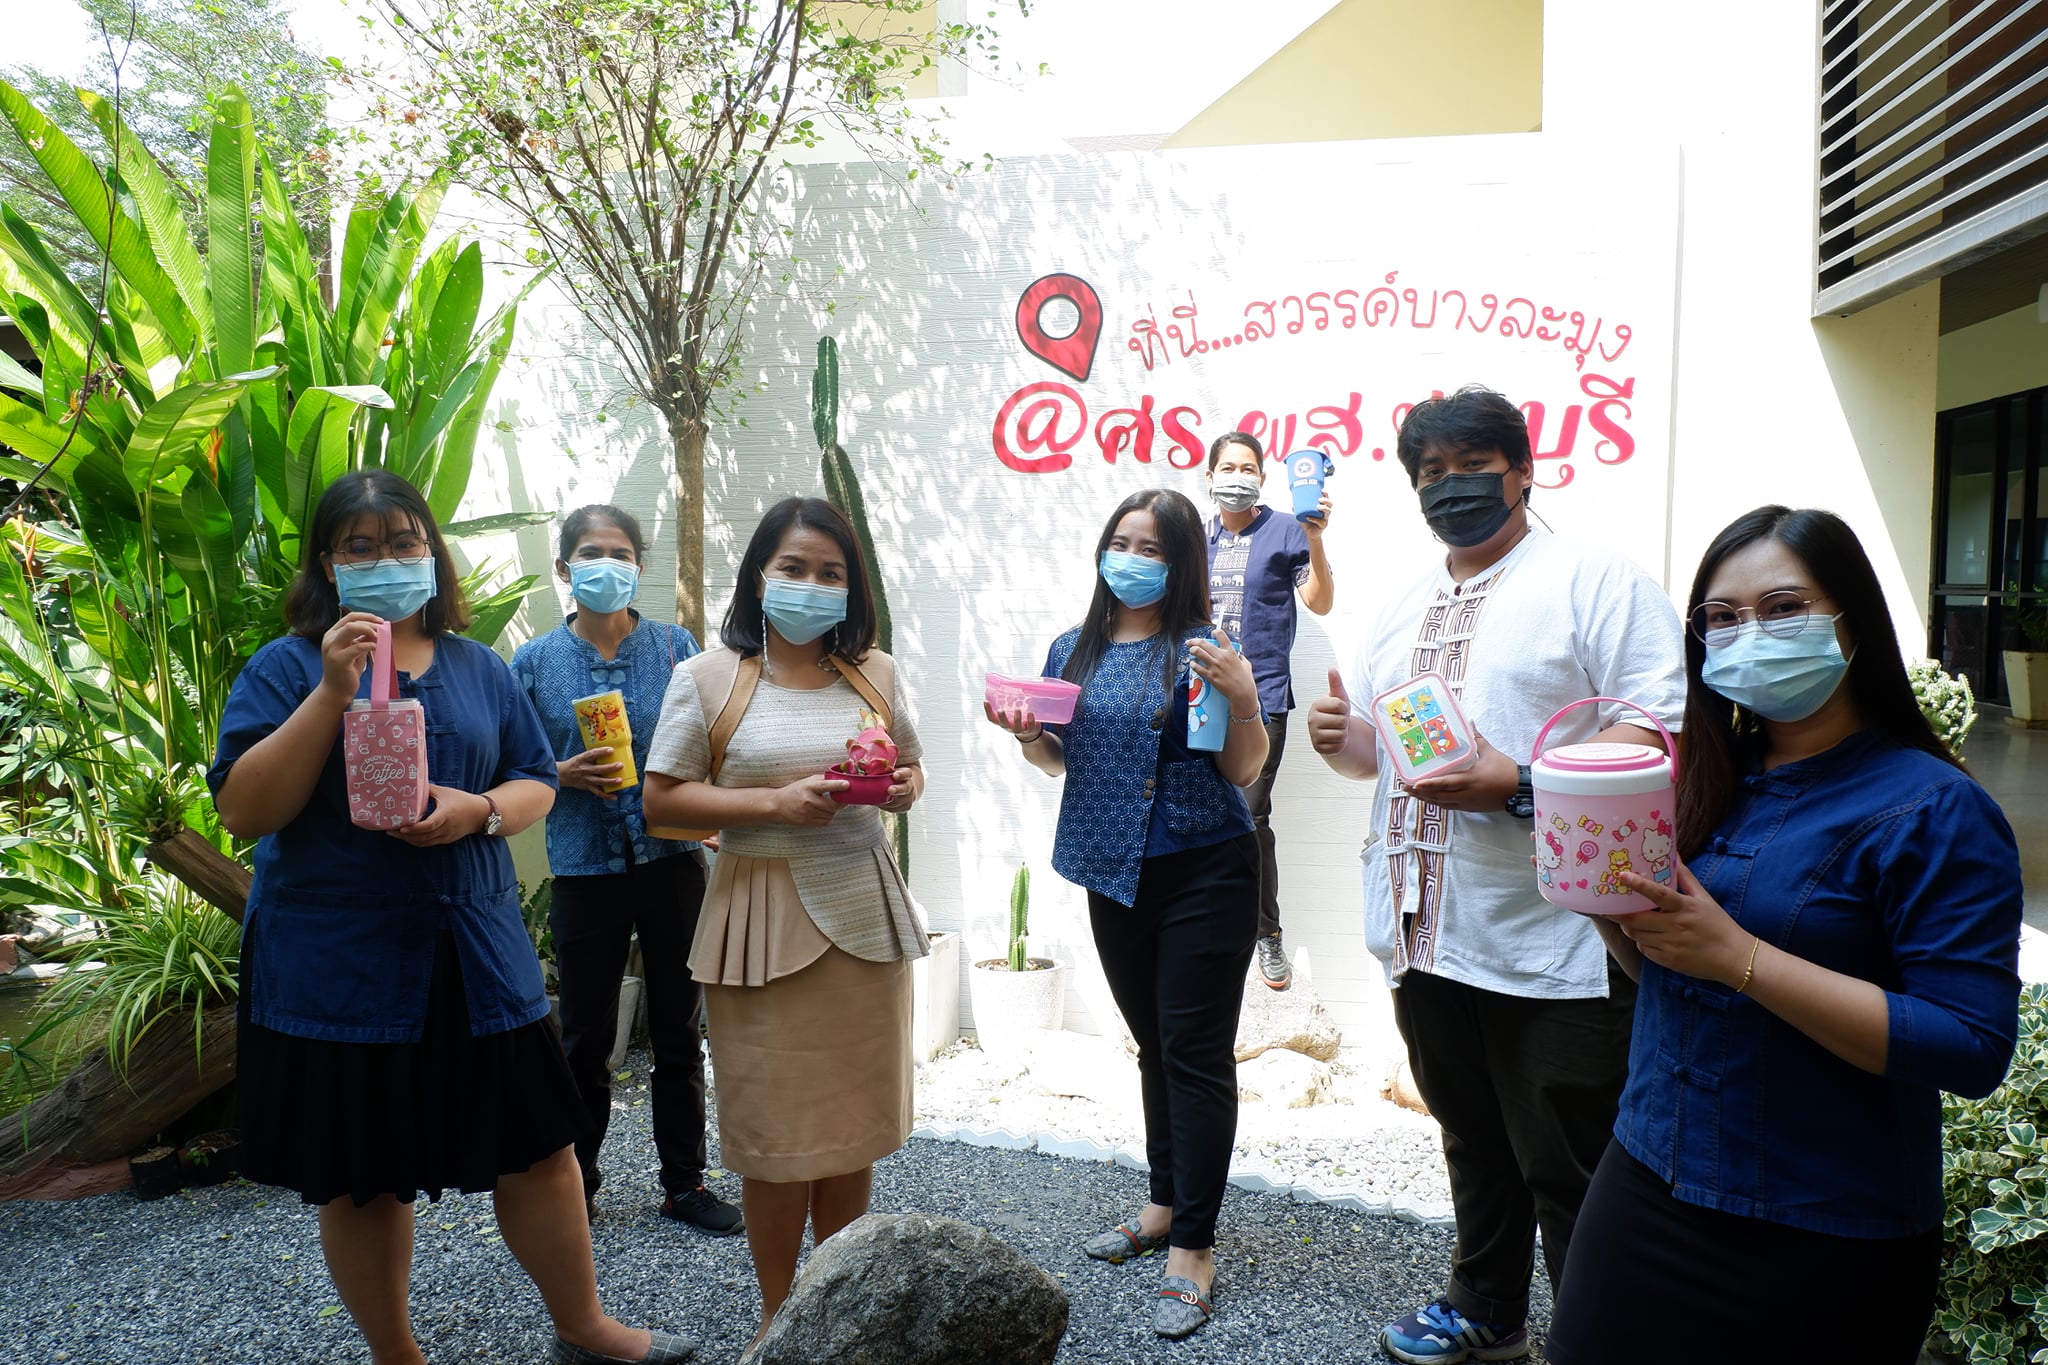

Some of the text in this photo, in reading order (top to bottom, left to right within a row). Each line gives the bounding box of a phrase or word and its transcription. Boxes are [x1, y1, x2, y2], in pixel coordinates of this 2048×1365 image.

[364, 755, 399, 763] ENJOY YOUR
[360, 762, 405, 784] Coffee
